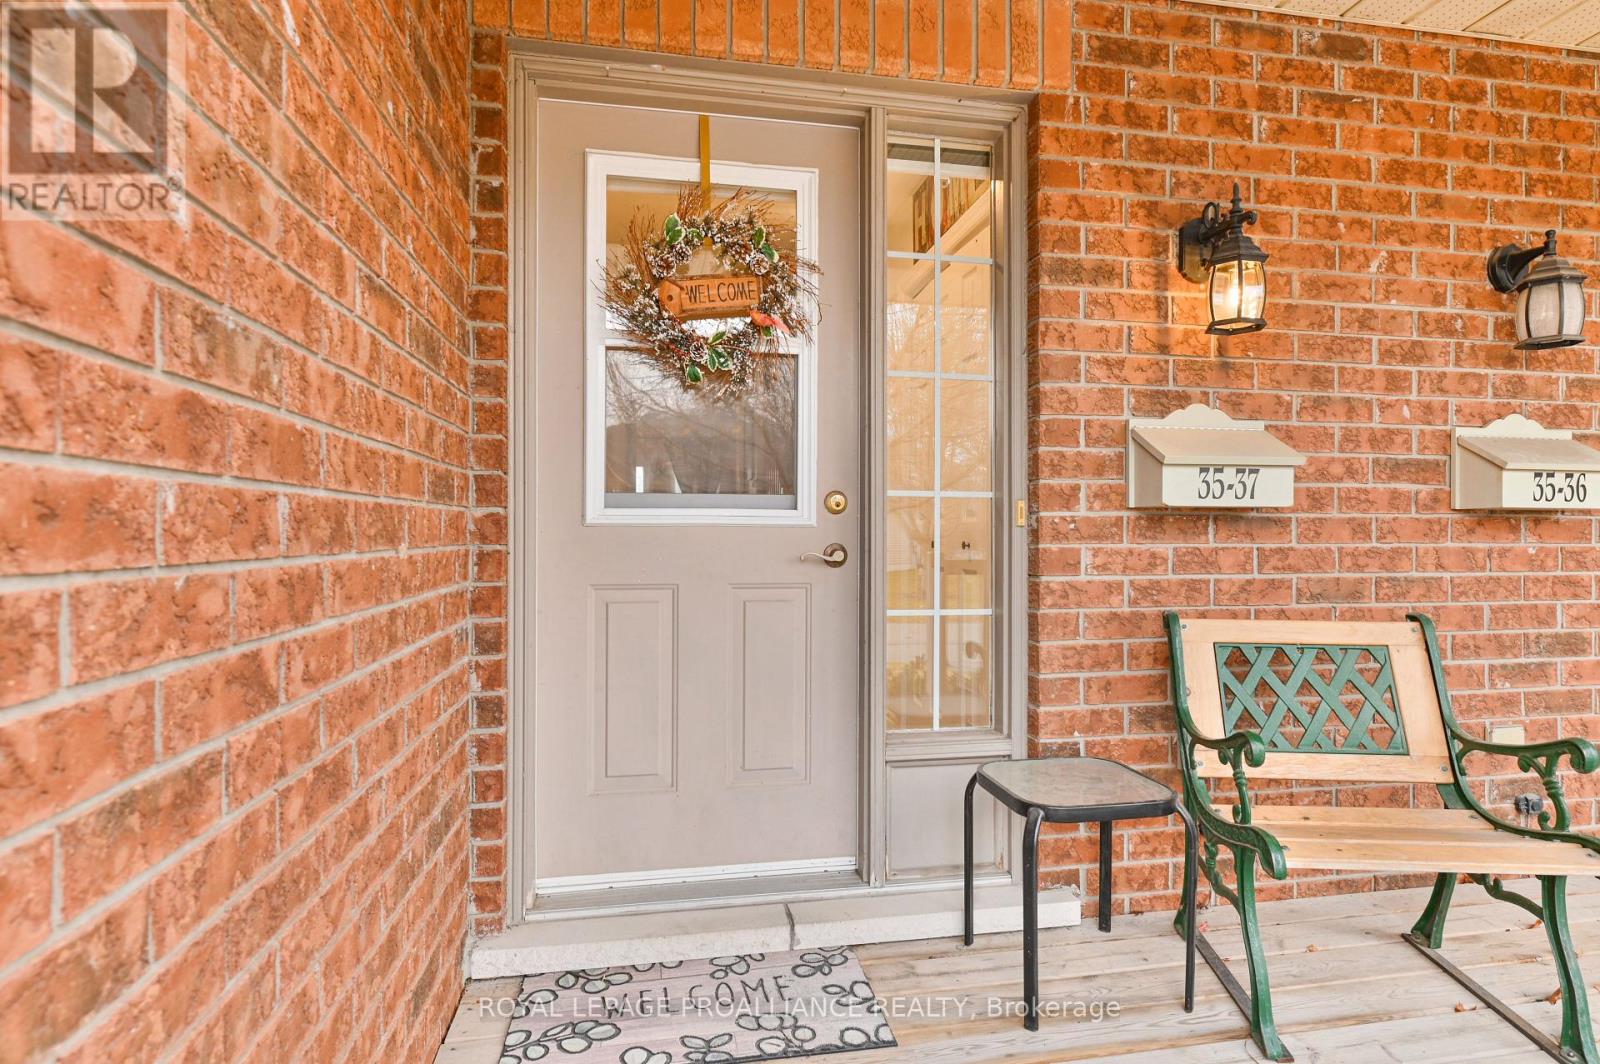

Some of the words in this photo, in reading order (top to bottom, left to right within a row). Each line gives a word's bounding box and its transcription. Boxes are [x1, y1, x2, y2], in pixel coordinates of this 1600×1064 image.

[685, 280, 756, 304] WELCOME
[1198, 466, 1260, 500] 35-37
[1533, 472, 1587, 503] 35-36
[601, 974, 795, 1019] WELCOME
